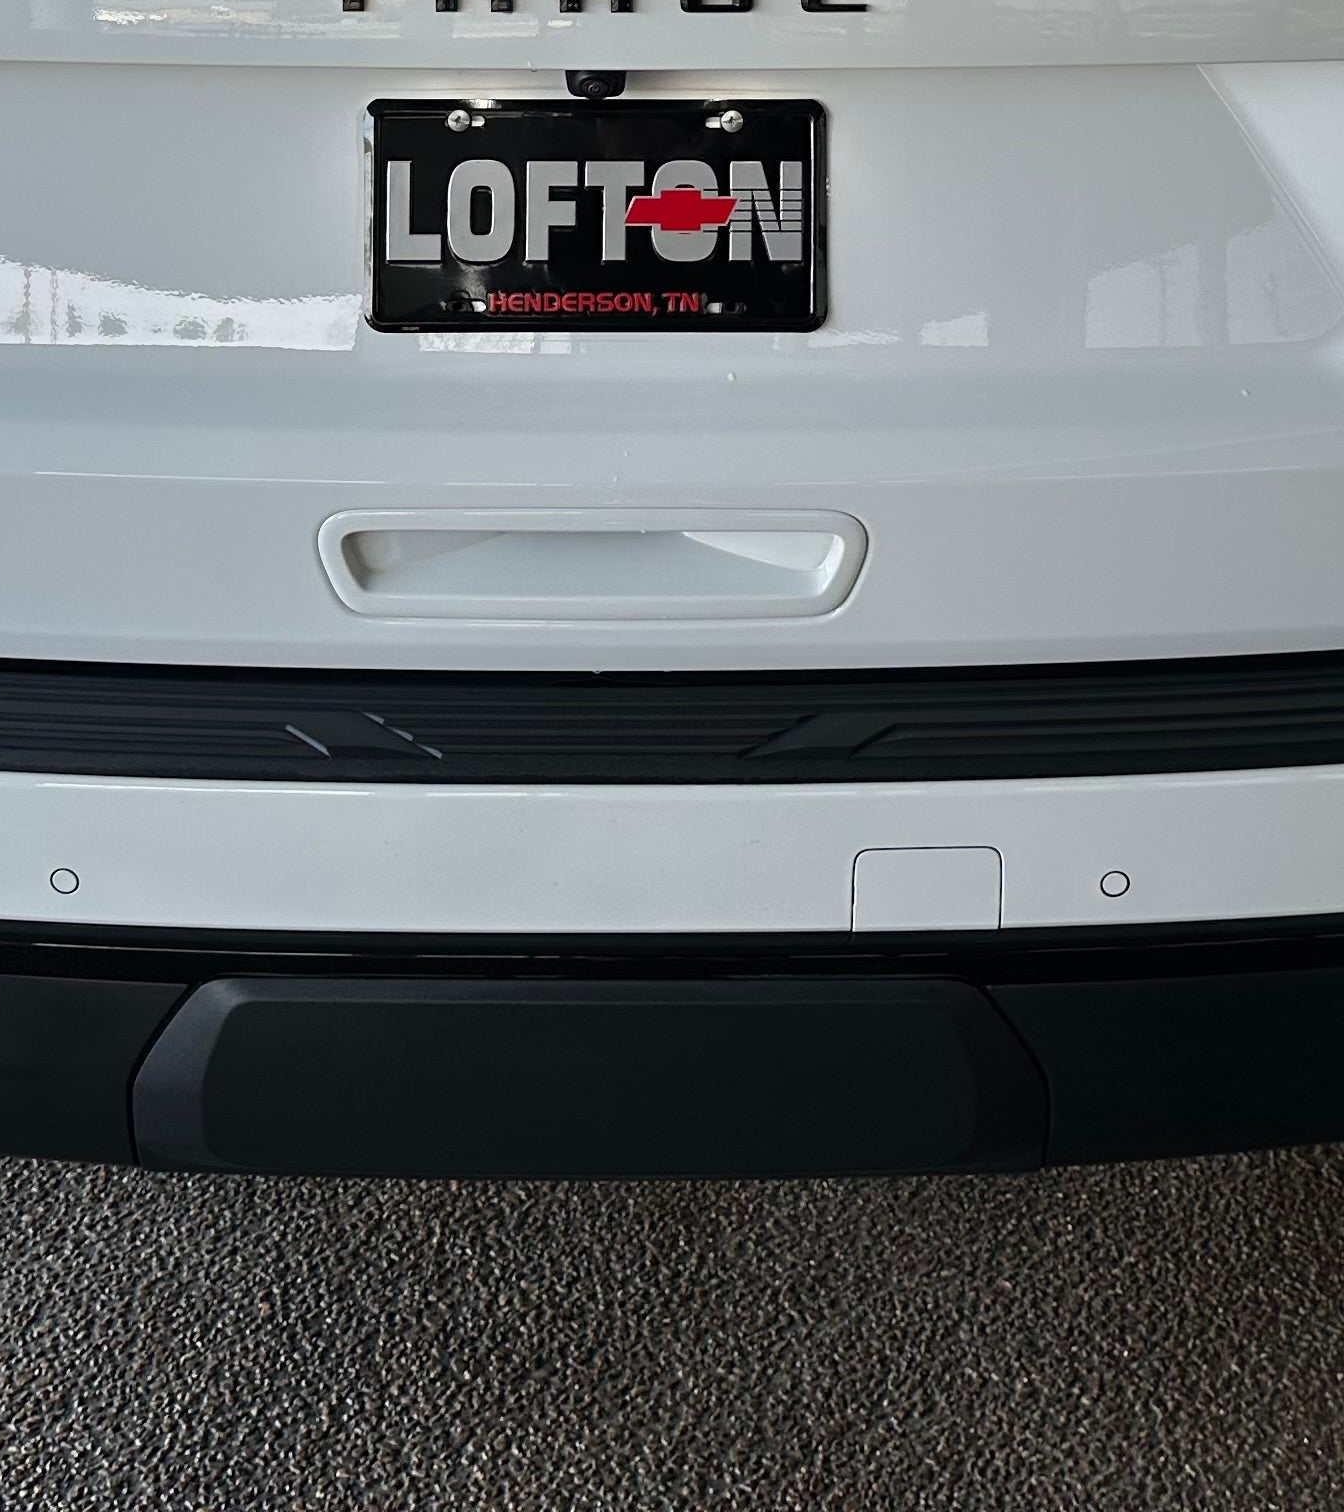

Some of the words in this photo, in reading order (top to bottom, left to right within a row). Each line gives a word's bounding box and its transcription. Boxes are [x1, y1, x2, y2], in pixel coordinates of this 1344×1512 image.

[386, 159, 803, 265] LOFTON
[489, 291, 657, 317] HENDERSON,
[664, 291, 700, 313] TN
